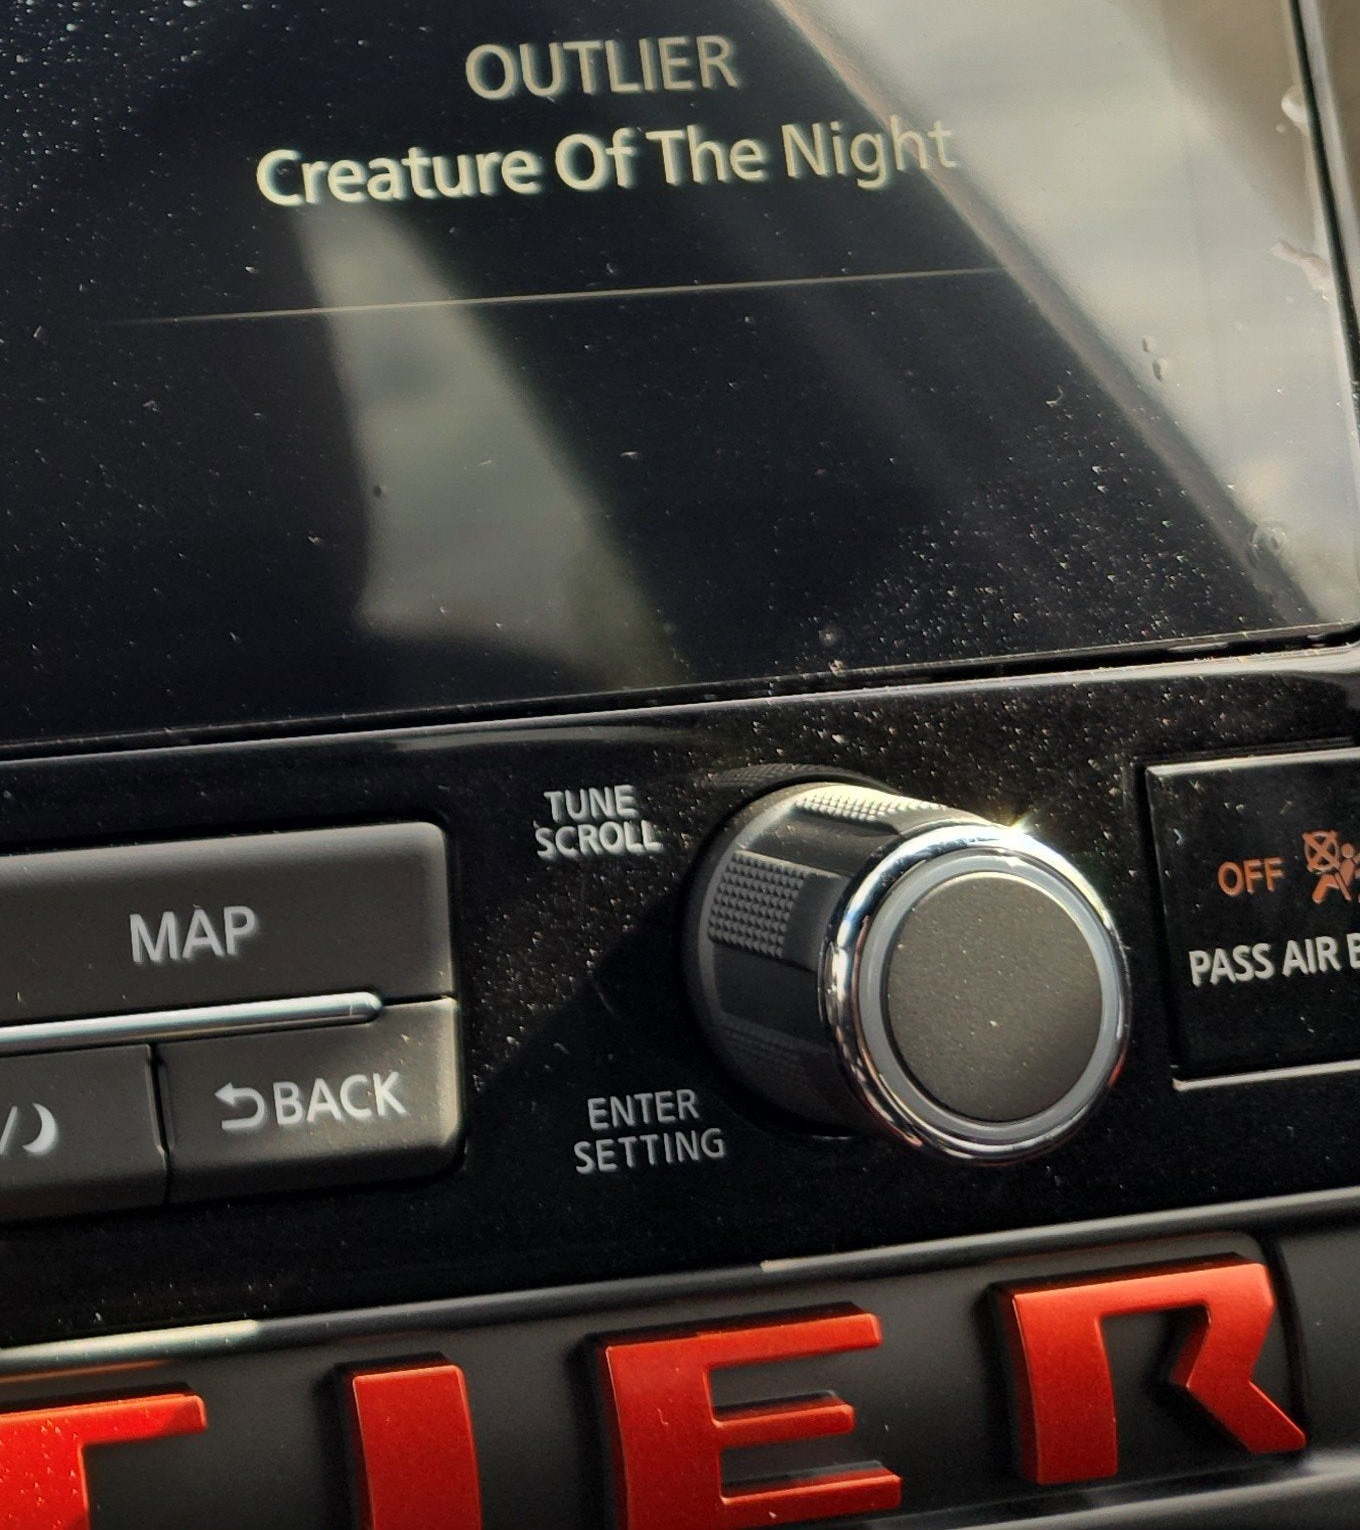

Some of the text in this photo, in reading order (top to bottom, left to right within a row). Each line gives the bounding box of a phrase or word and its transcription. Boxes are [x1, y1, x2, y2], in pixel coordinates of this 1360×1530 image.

[466, 36, 739, 101] OUTLIER
[257, 118, 955, 206] Creature Of The Night
[545, 786, 638, 820] TUNE
[536, 819, 662, 858] SCROLL
[1218, 857, 1283, 896] OFF
[130, 906, 257, 963] MAP
[1189, 943, 1274, 986] PASS
[1282, 936, 1341, 976] AIR
[274, 1072, 407, 1126] BACK
[588, 1090, 699, 1129] ENTER
[575, 1129, 725, 1174] SETTING
